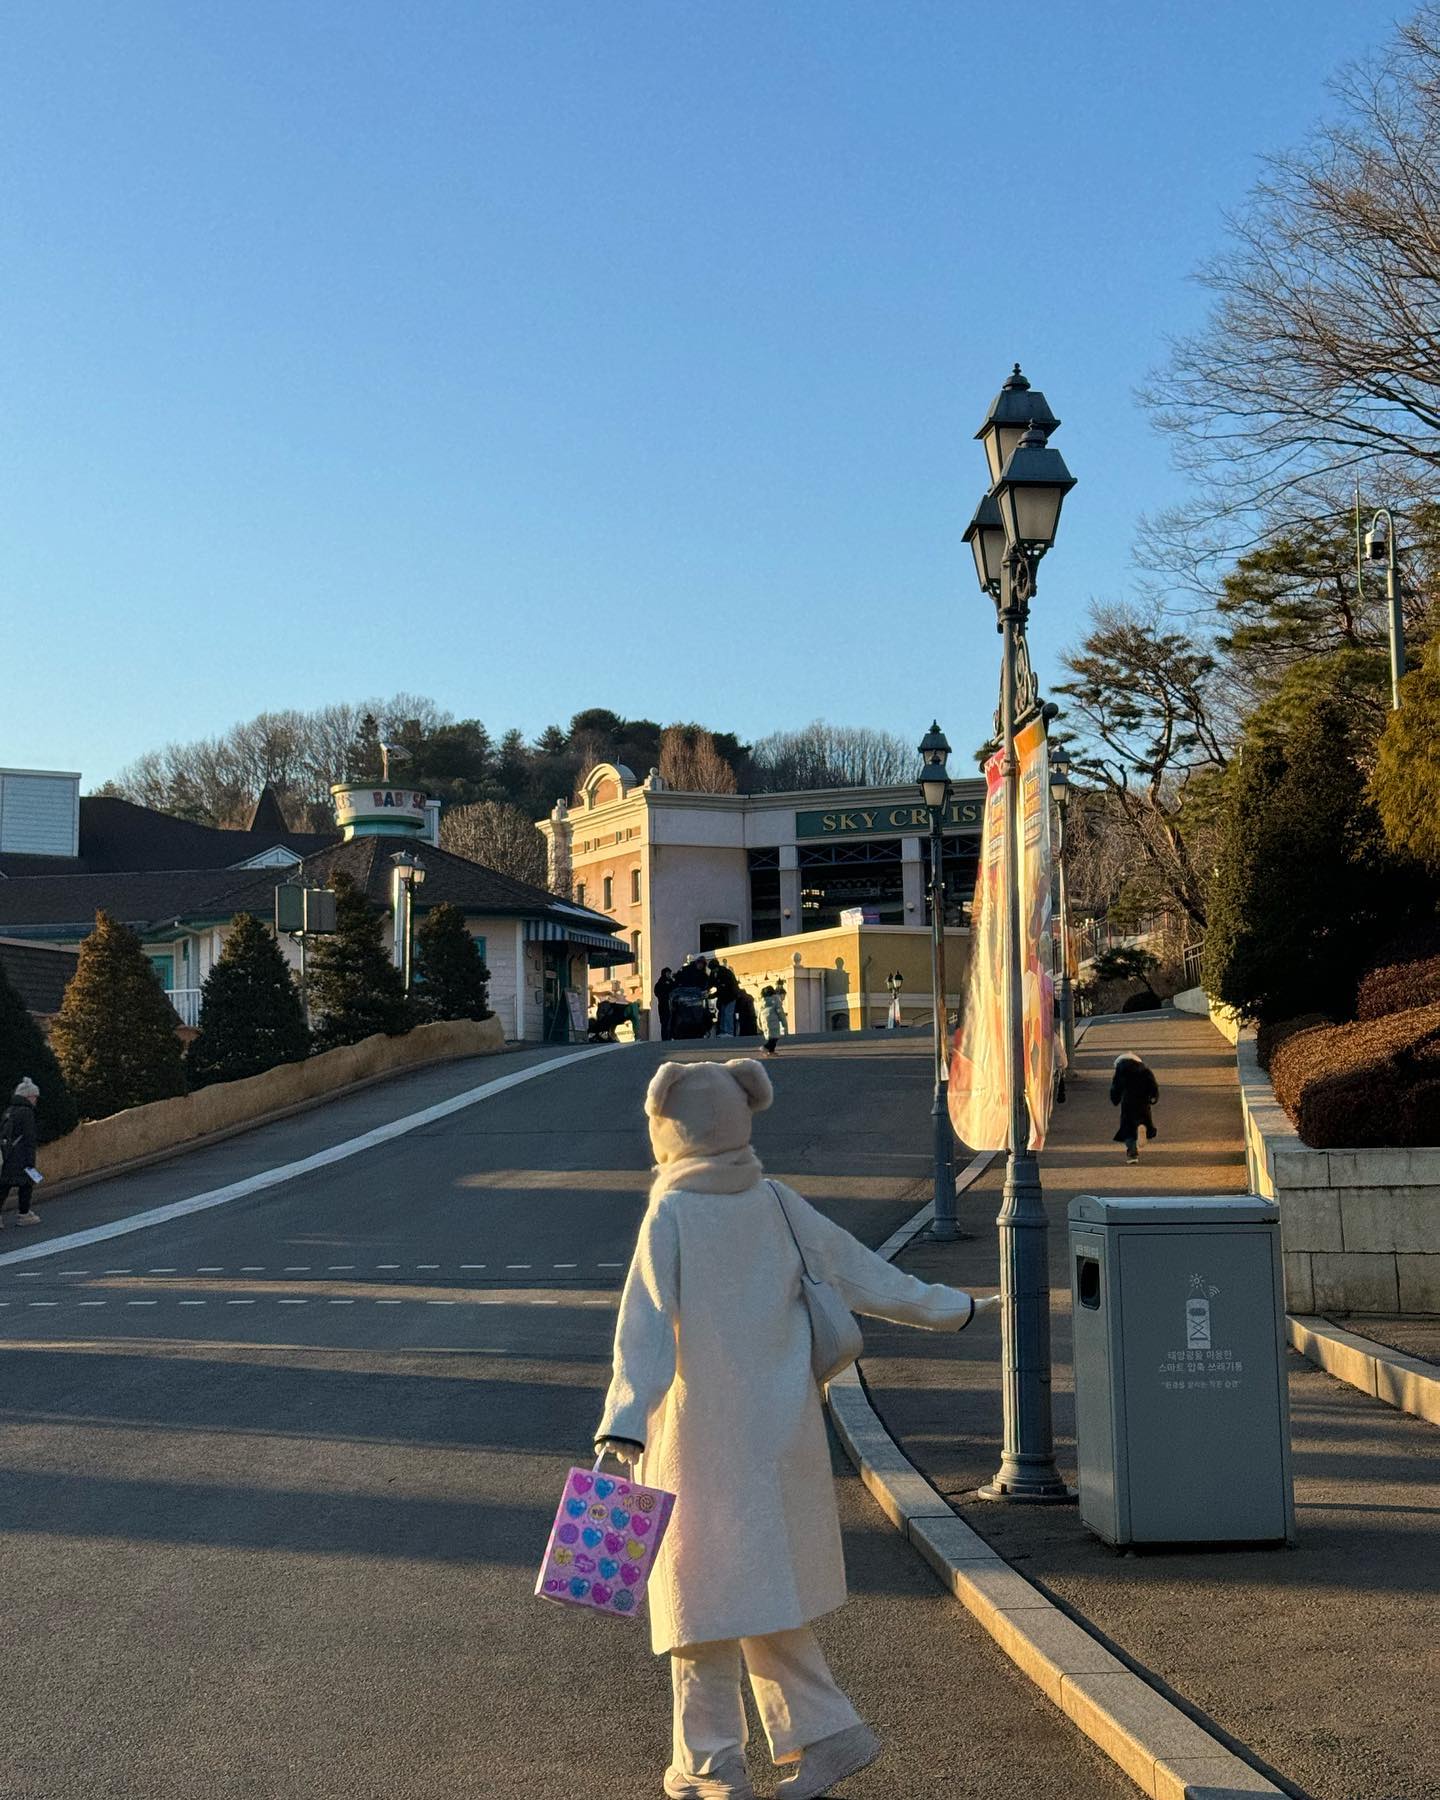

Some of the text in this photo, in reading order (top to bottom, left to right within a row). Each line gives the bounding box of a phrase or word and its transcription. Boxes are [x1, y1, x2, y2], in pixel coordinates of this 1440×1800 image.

[822, 811, 878, 831] SKY
[889, 804, 986, 827] CRIS
[1159, 1363, 1185, 1372] 스마트
